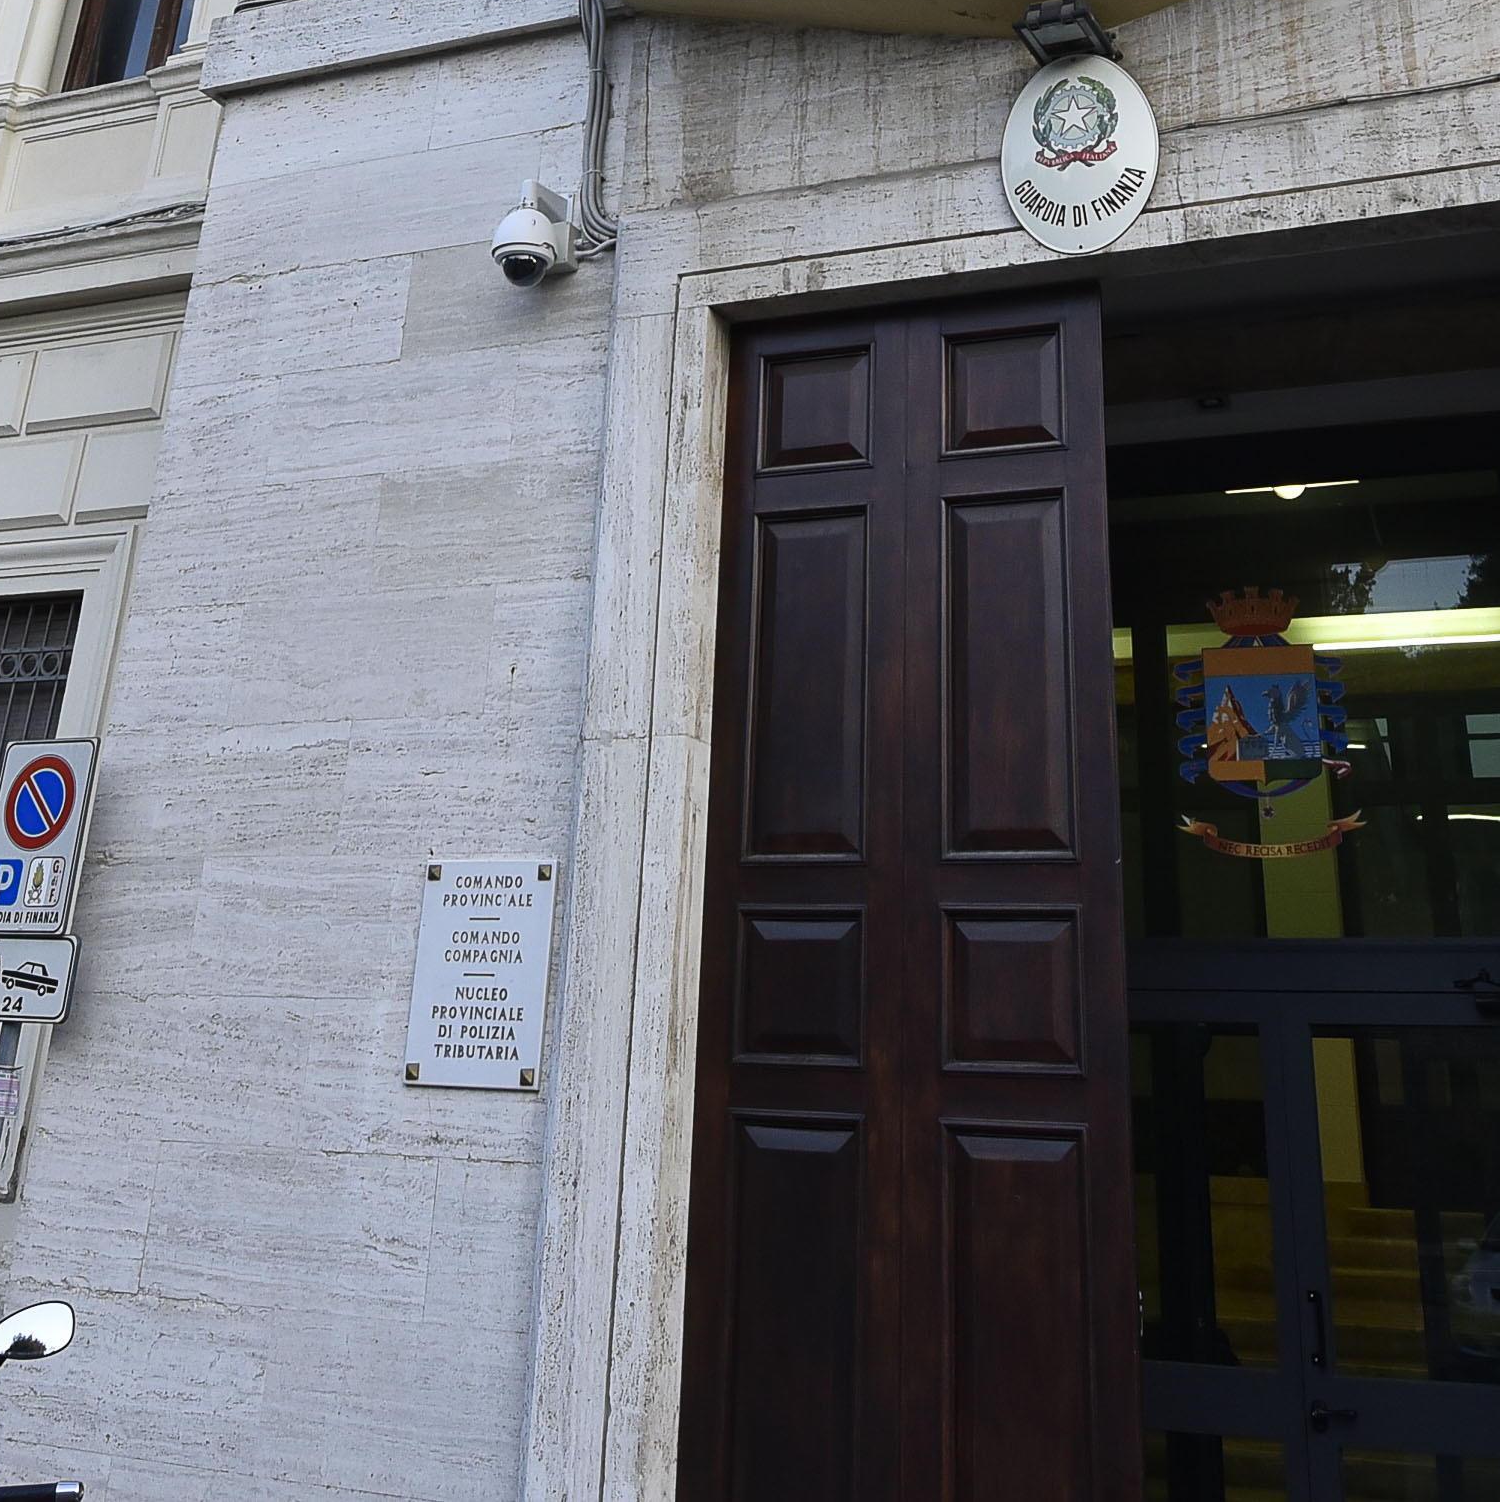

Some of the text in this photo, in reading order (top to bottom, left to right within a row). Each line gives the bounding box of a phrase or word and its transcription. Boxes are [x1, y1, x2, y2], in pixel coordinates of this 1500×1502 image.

[1014, 167, 1147, 228] GUARDIA DI FINANZA
[1220, 841, 1241, 855] NEC
[1245, 846, 1283, 857] RECISA
[52, 859, 62, 874] G.
[455, 876, 523, 889] COMANDO
[13, 911, 23, 924] DI
[25, 911, 59, 924] FINANZA
[452, 931, 520, 944] COMANDO
[444, 949, 523, 963] COMPAGNIA
[455, 986, 508, 1002] NUCLEO
[431, 1006, 524, 1022] PROVINCIALE
[438, 1025, 516, 1041] DI POLIZIA
[434, 1044, 519, 1061] TRIBUTARIA
